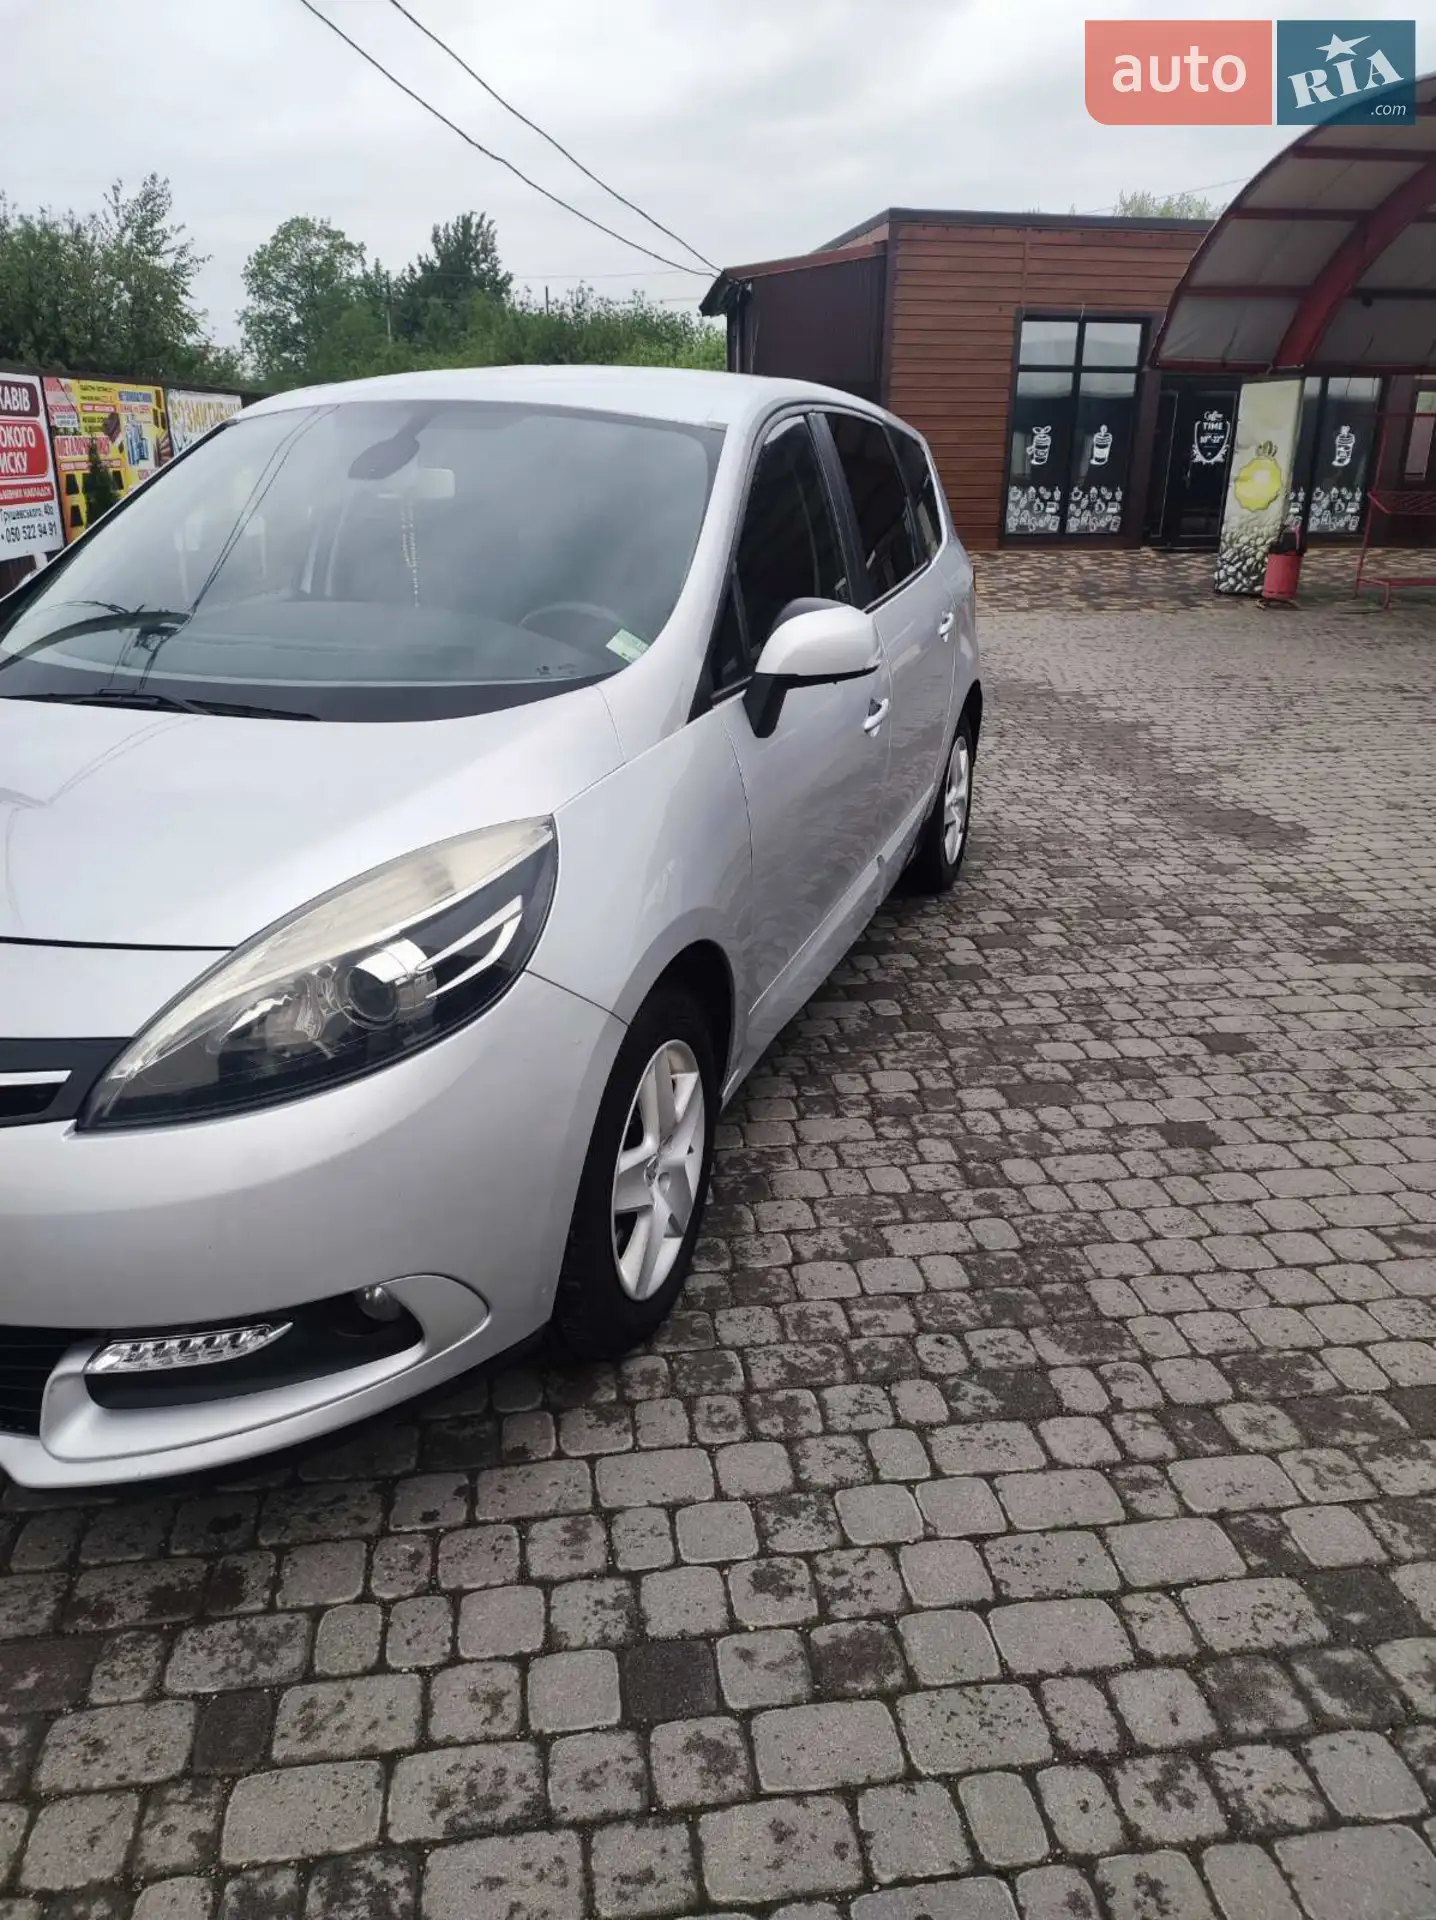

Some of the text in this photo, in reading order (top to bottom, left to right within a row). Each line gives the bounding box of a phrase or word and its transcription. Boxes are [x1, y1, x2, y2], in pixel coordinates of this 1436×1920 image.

[1203, 422, 1224, 431] TIME
[6, 527, 20, 543] 050
[22, 524, 36, 540] 522
